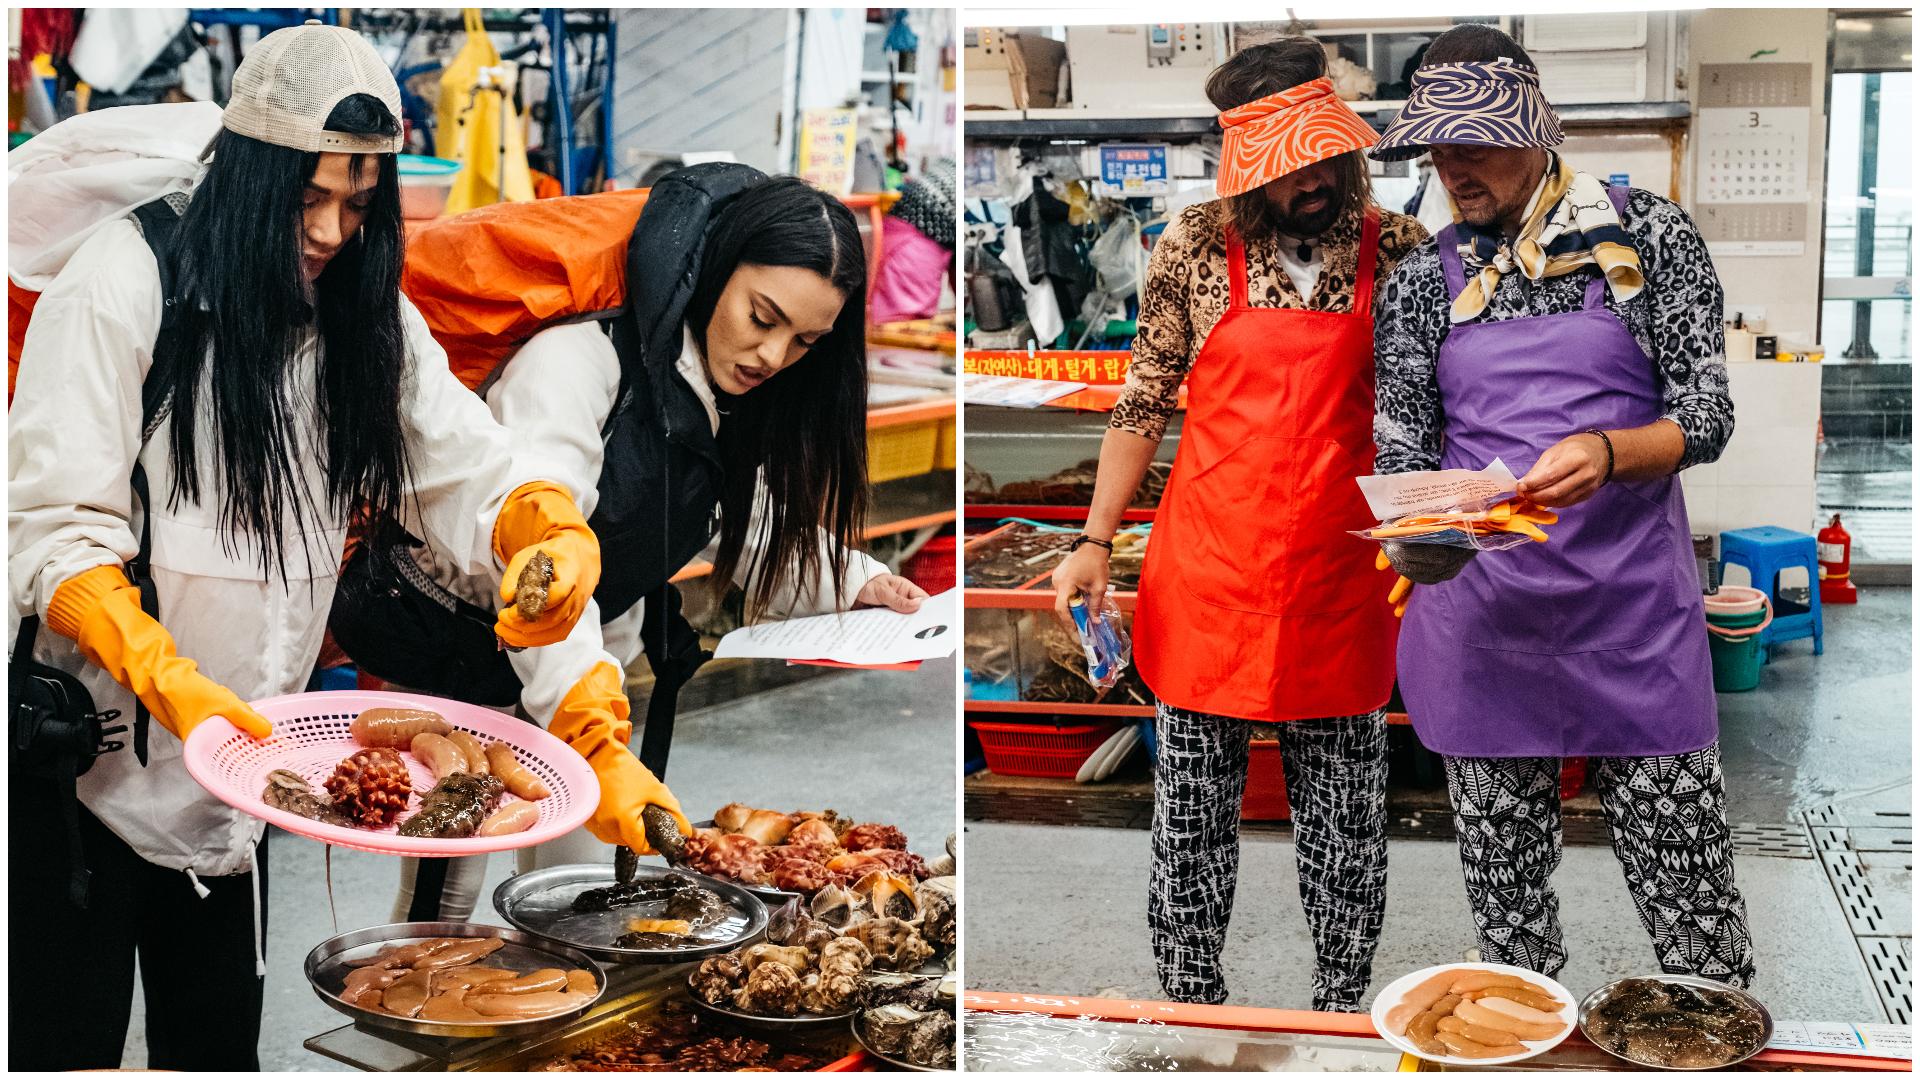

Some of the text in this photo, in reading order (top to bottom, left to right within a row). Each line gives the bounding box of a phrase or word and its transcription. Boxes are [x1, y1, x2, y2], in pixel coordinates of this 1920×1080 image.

[1712, 73, 1719, 84] 2
[1749, 112, 1759, 128] 3
[1708, 208, 1716, 217] 4
